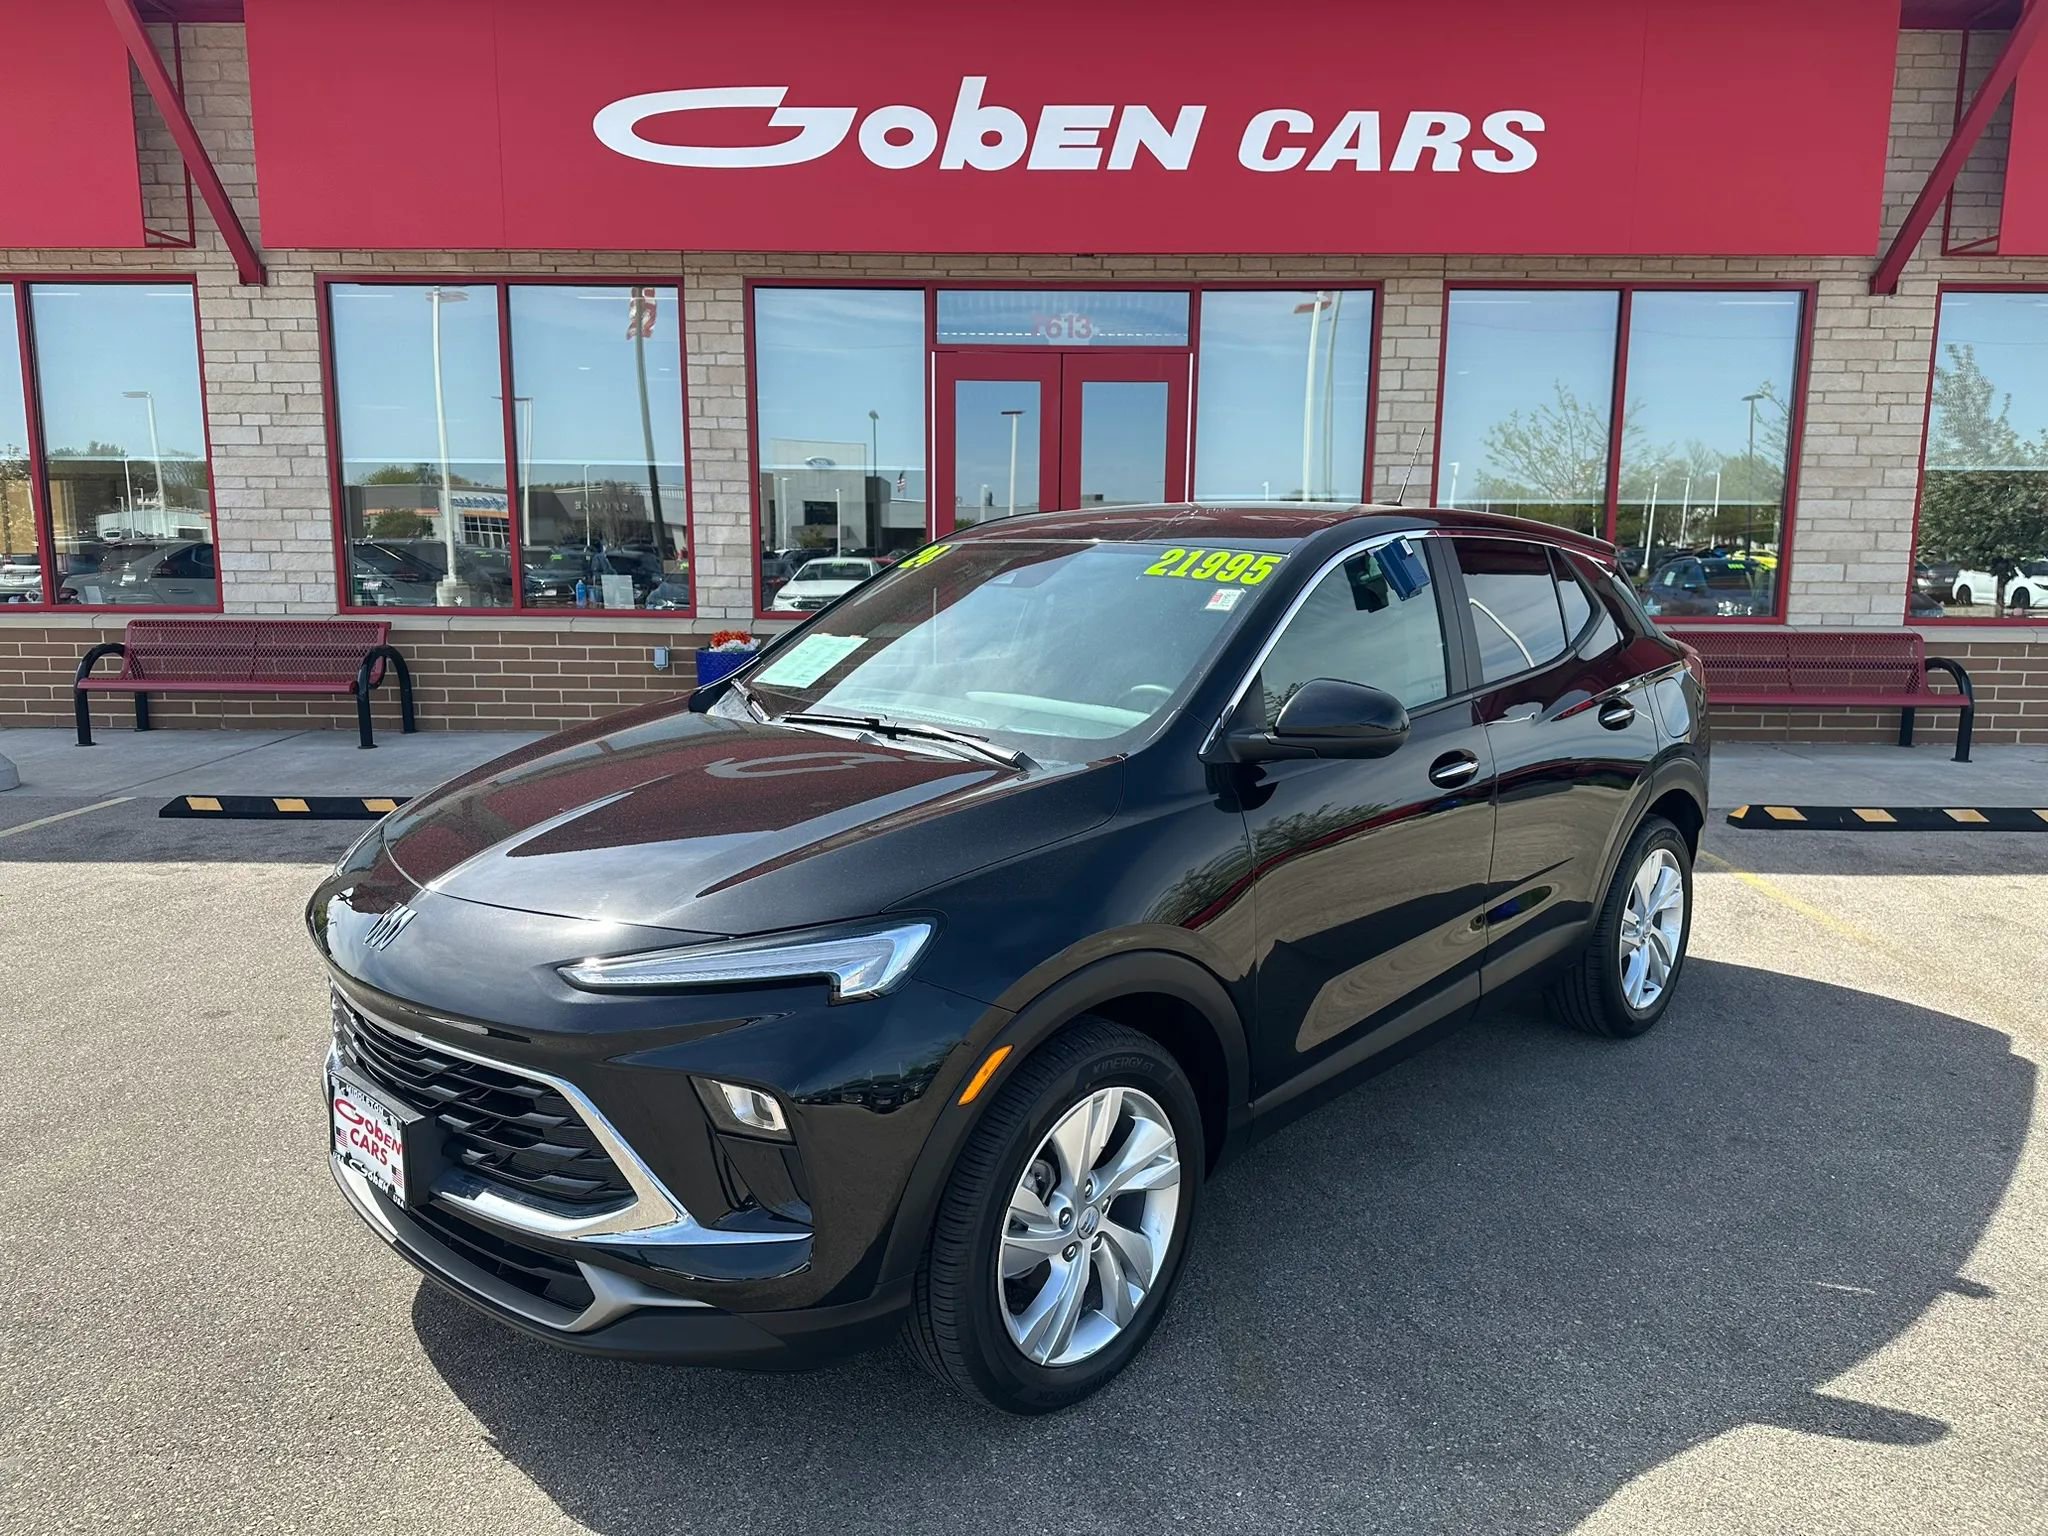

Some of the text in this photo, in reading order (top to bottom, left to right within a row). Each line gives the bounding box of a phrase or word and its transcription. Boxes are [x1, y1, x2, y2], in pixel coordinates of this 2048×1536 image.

[1238, 109, 1546, 174] CARS
[1143, 549, 1283, 585] 21995
[350, 1127, 388, 1166] CARS
